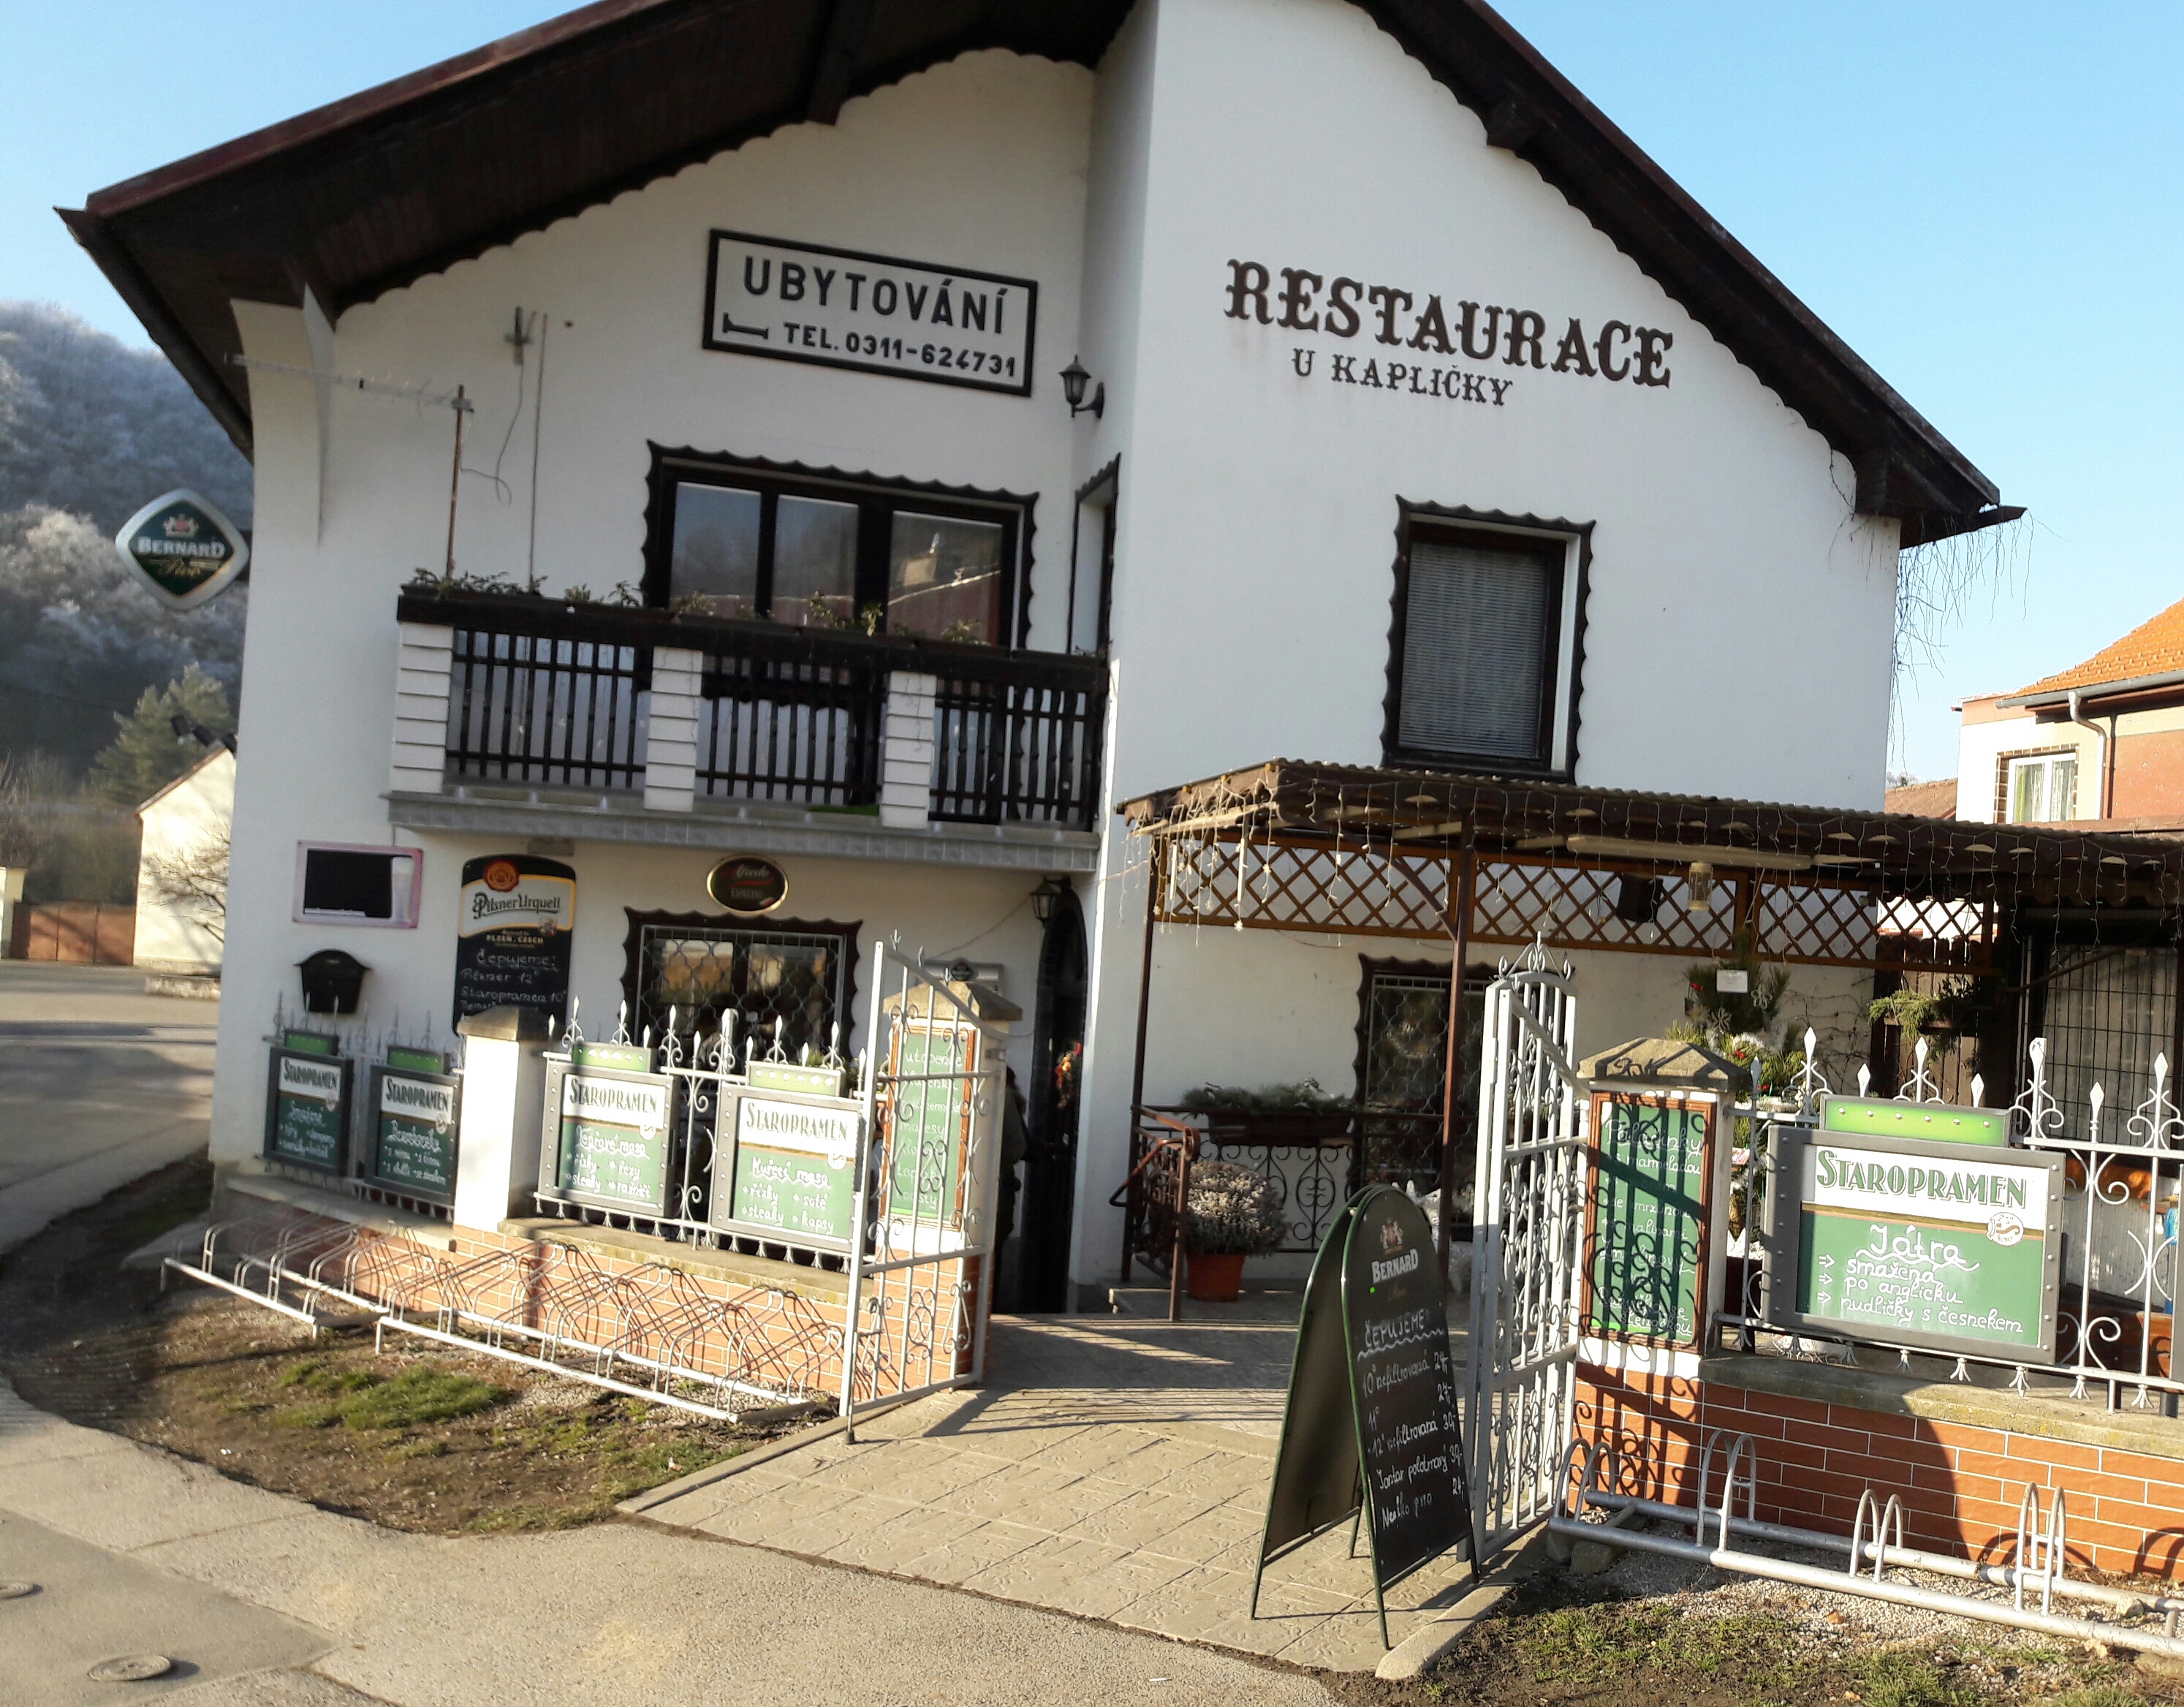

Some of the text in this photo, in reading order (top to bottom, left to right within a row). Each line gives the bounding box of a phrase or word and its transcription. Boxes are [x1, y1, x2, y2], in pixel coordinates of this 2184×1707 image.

[743, 256, 1009, 333] UBYTOVÁNÍ
[1224, 259, 1673, 388] RESTAURACE
[784, 322, 1015, 377] TEL. 0311-624731
[1292, 348, 1513, 406] U KAPLIČKY
[137, 536, 225, 559] BERNARD
[472, 891, 561, 920] Pilsner Urquell
[387, 1077, 450, 1112] STAROPRAMEN
[569, 1078, 657, 1114] STAROPRAMEN
[746, 1102, 847, 1140] STAROPRAMEN
[620, 1140, 646, 1155] maso
[572, 1172, 601, 1193] steaky
[796, 1169, 830, 1186] maso
[1816, 1149, 2027, 1209] STAROPRAMEN
[748, 1205, 834, 1235] steaky kapsy
[1869, 1224, 1967, 1263] Játra
[1371, 1249, 1419, 1284] BERNARD
[1844, 1276, 1964, 1306] po anglicku
[1840, 1294, 2024, 1333] nudličky s česnekem
[1387, 1410, 1438, 1453] nefiltrovaná
